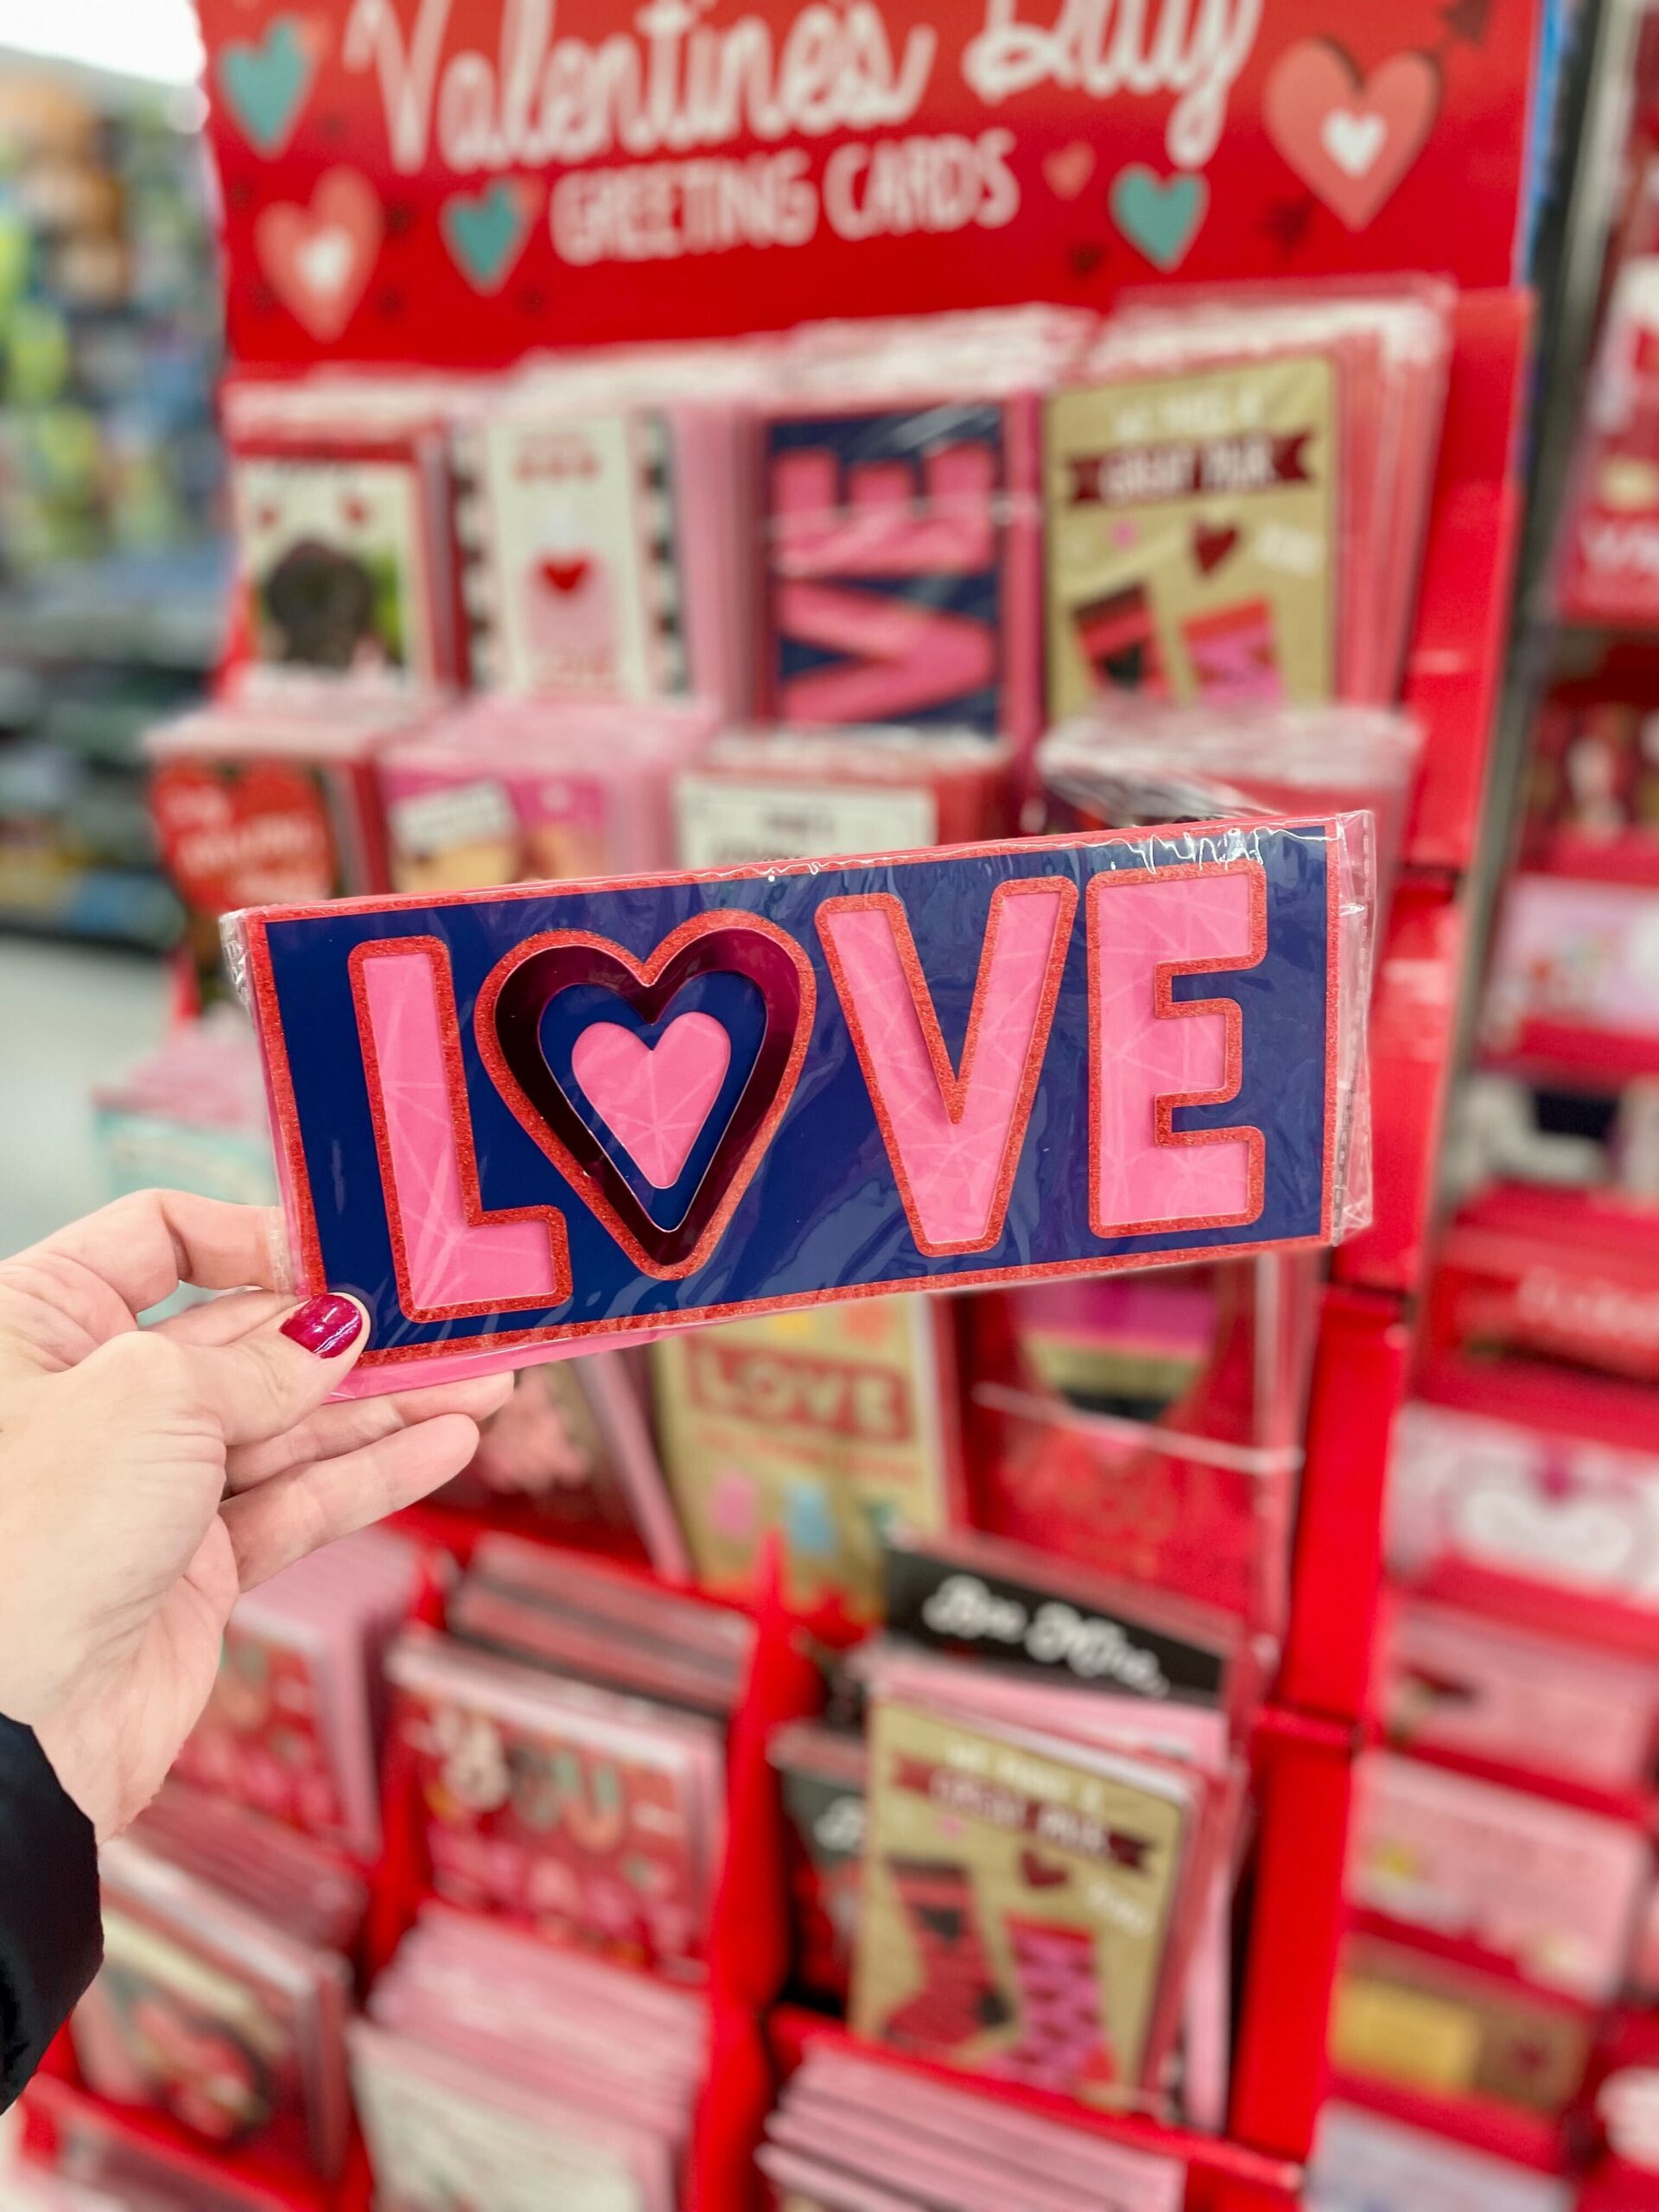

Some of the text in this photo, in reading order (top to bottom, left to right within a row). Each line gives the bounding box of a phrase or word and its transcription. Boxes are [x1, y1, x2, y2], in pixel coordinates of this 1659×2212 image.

[342, 0, 937, 175] Valentines
[550, 128, 1021, 266] GREETING CARDS
[348, 859, 1267, 1322] LOVE
[691, 1344, 903, 1434] LOVE
